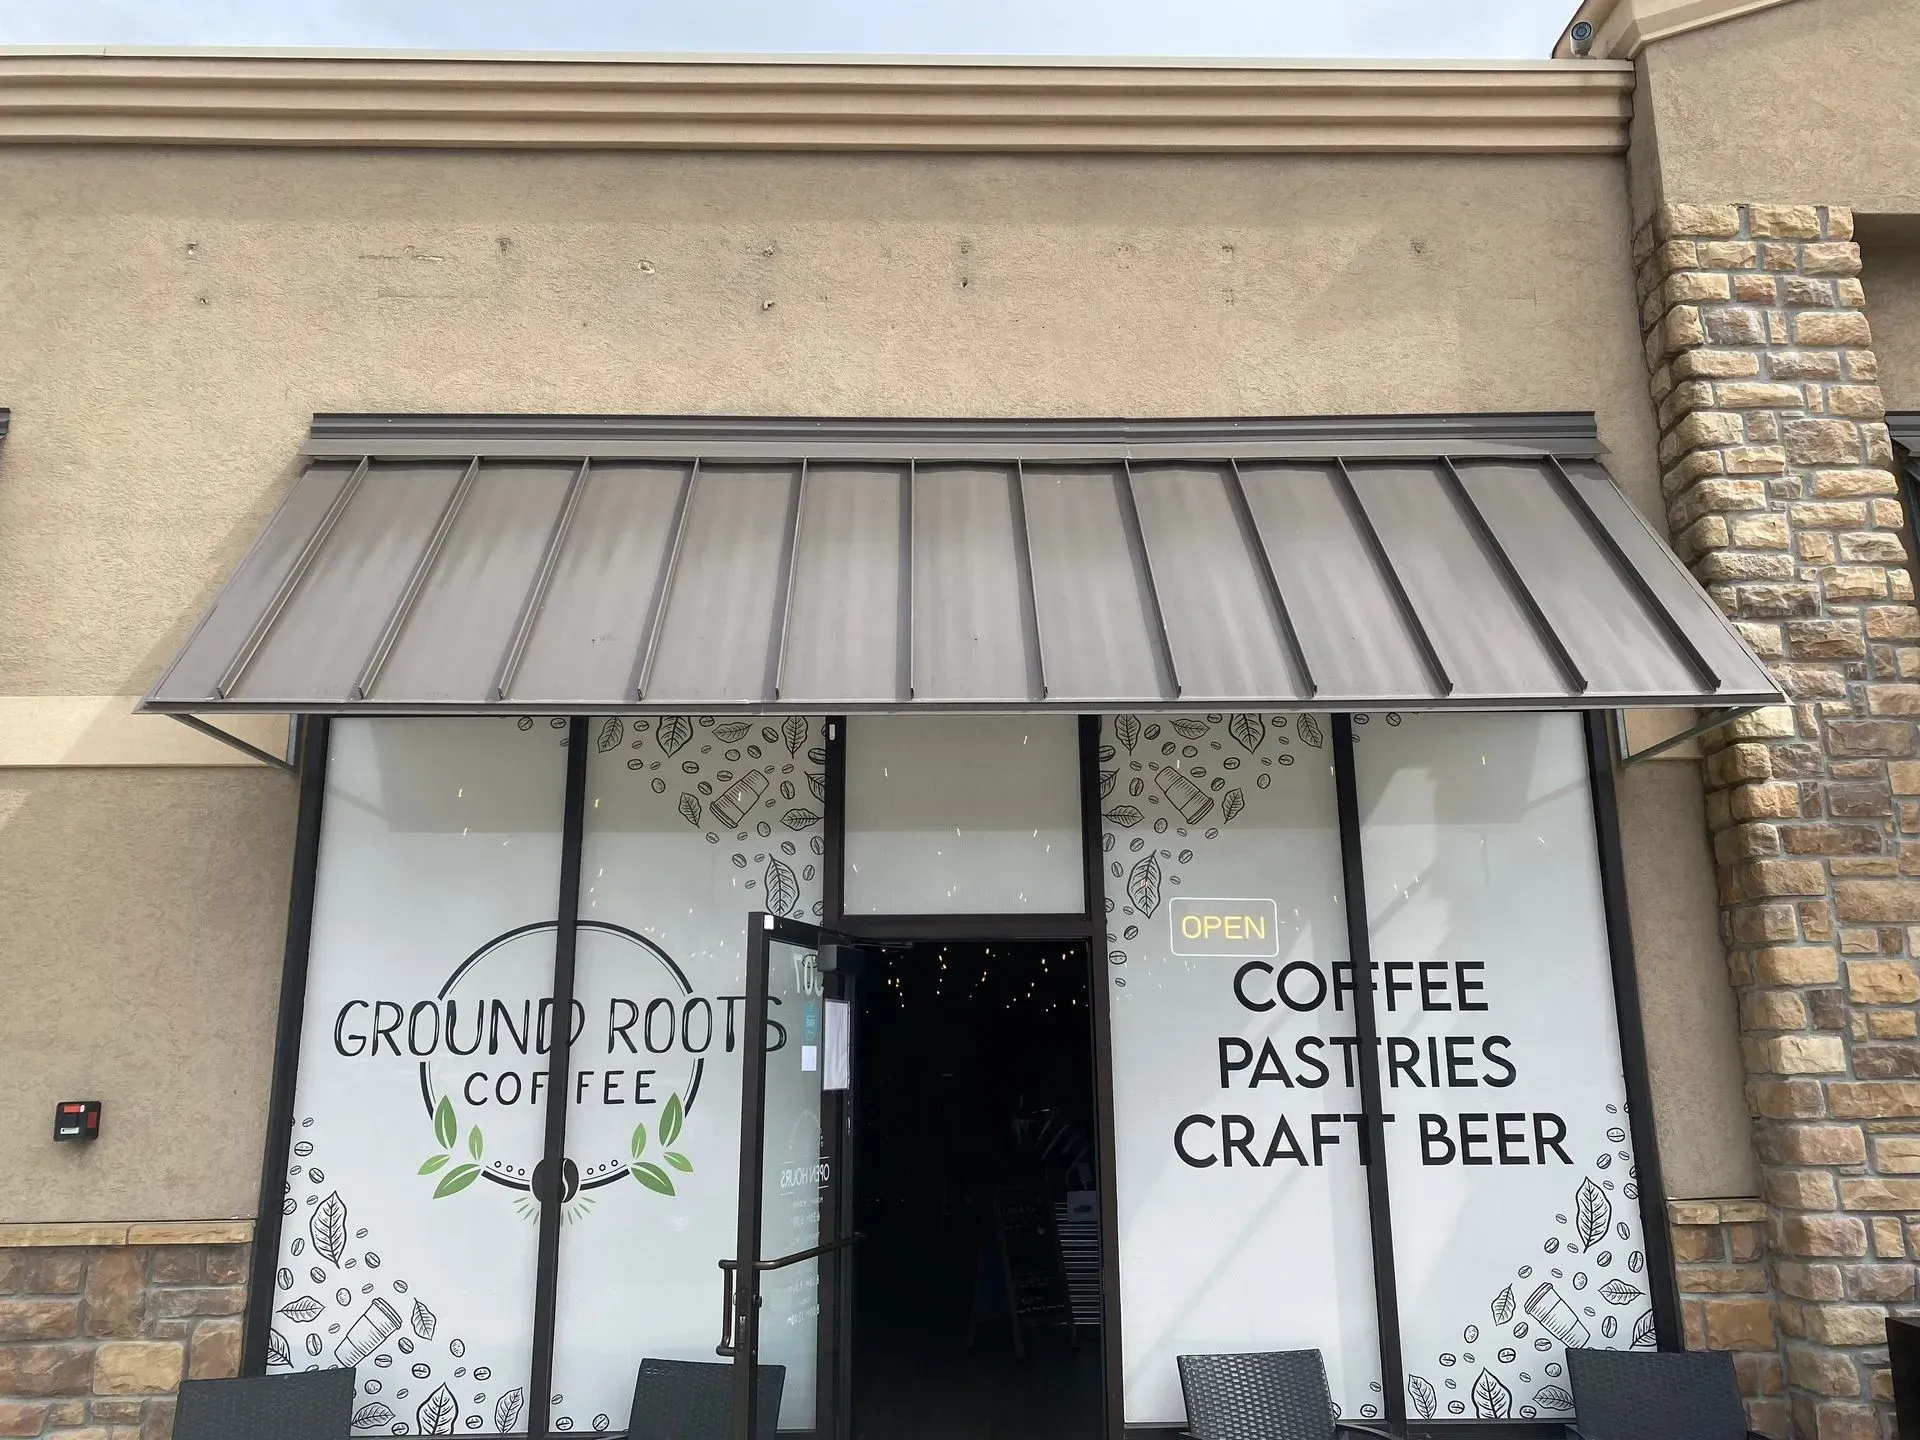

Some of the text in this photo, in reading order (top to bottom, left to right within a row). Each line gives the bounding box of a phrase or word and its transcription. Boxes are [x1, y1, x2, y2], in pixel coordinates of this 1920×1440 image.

[1181, 914, 1266, 940] OPEN
[1233, 960, 1489, 1012] COFFEE
[333, 997, 585, 1057] GROUND
[463, 1070, 656, 1105] COFFEE
[1218, 1035, 1517, 1088] PASTRIES
[1173, 1112, 1574, 1169] CRAFT BEER
